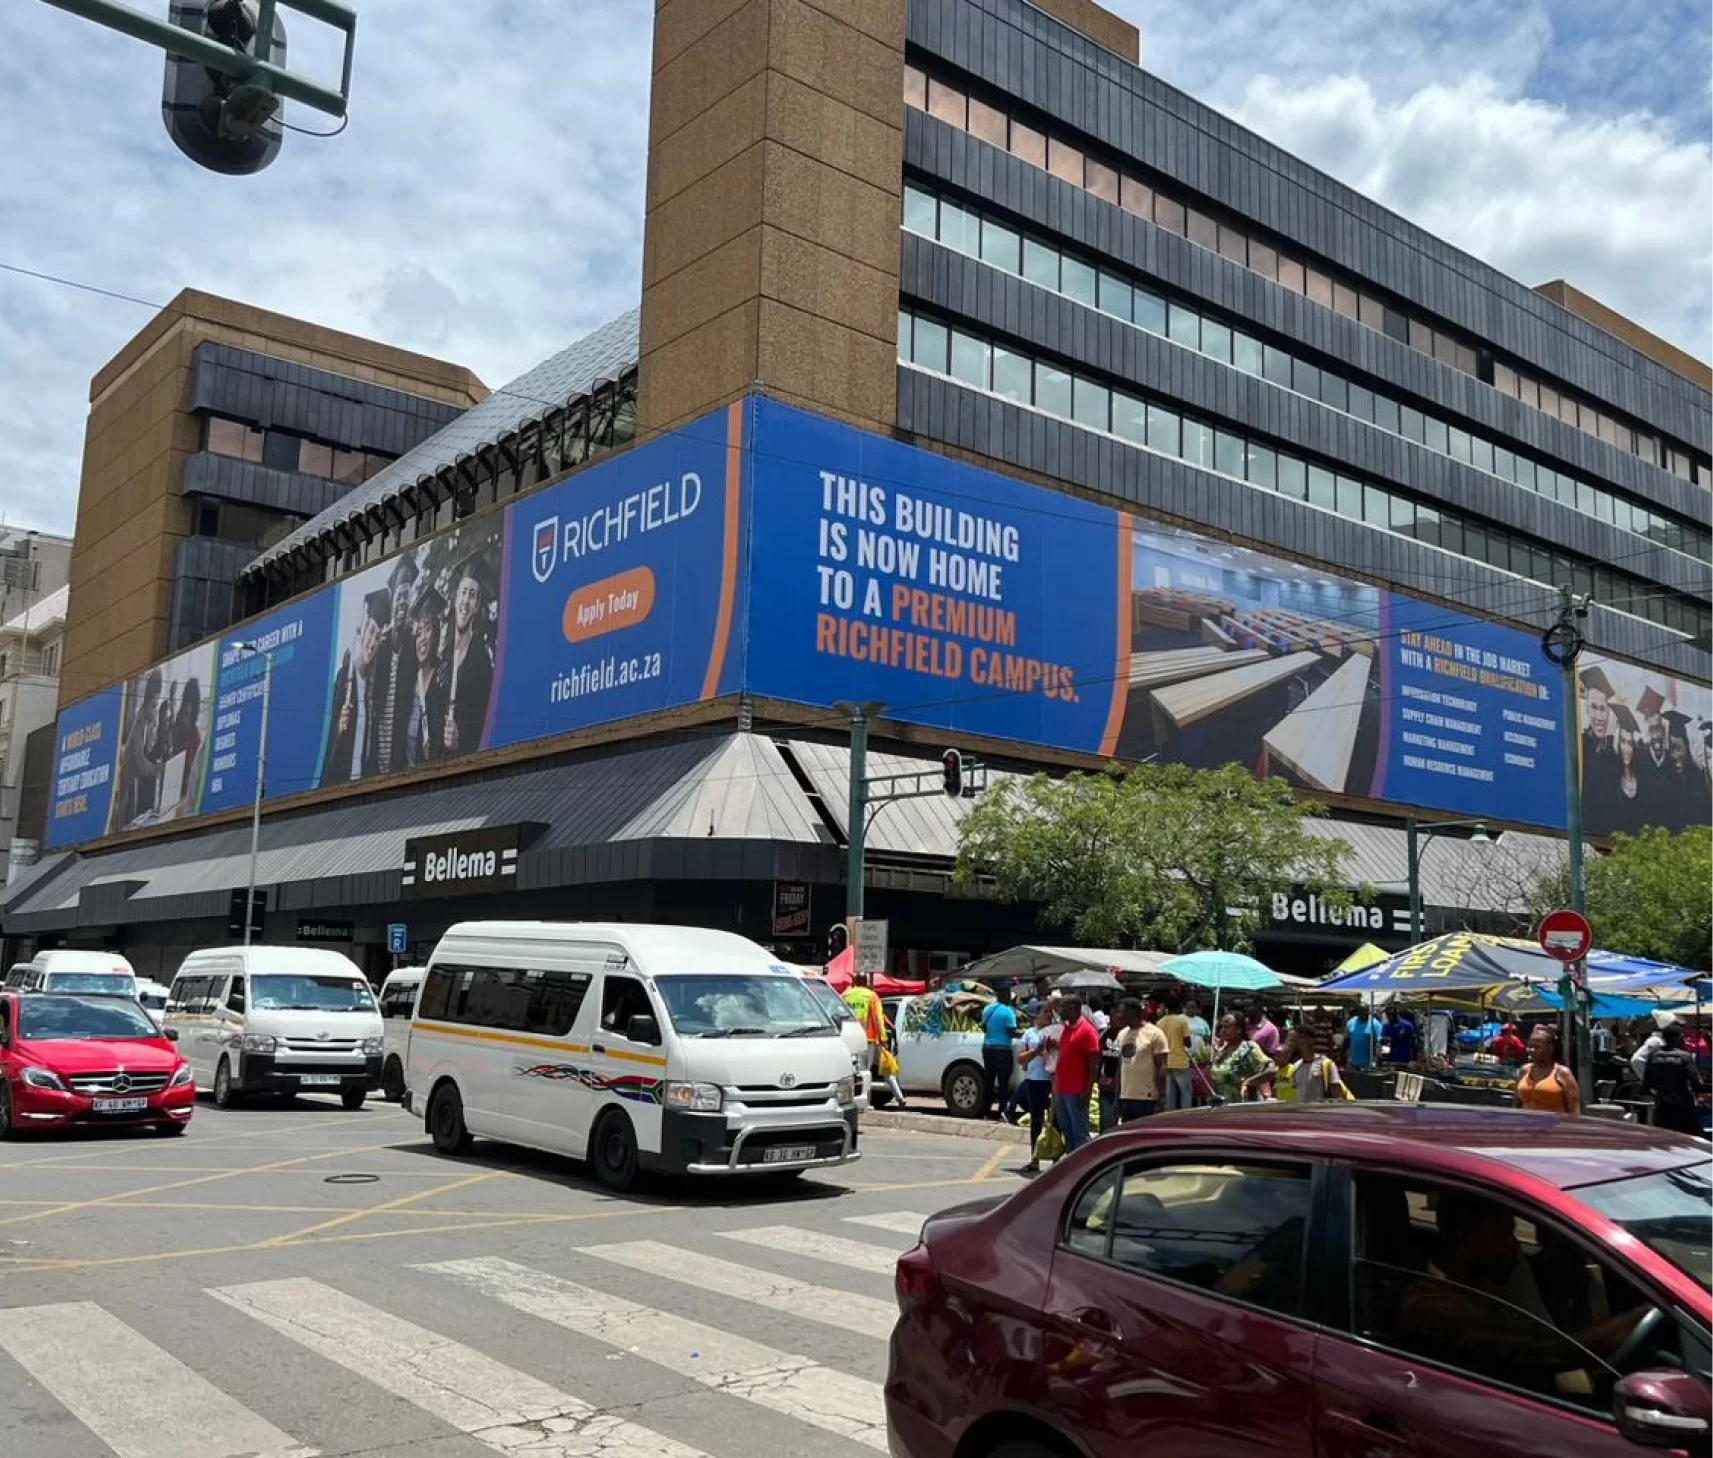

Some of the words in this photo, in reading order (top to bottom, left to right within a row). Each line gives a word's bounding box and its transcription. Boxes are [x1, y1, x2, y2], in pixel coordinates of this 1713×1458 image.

[563, 471, 702, 563] RICHFIELD
[819, 470, 887, 526] THIS
[894, 493, 1020, 562] BUILDING
[819, 518, 848, 562] IS
[857, 528, 920, 580] NOW
[928, 547, 1003, 601] HOME
[577, 603, 604, 627] Apply
[608, 589, 640, 616] Today
[816, 565, 854, 610] TO
[863, 578, 882, 618] A
[891, 583, 1017, 648] PREMIUM
[551, 652, 662, 704] richfield.ac.za
[816, 612, 963, 680] RICHFIELD
[969, 646, 1081, 703] CAMPUS.
[1400, 628, 1422, 648] STAY
[1424, 634, 1453, 657] AHEAD
[1465, 646, 1481, 666] THE
[1483, 651, 1498, 669] JOB
[1499, 656, 1531, 678] MARKET
[1400, 648, 1423, 669] WITH
[1425, 655, 1432, 672] A
[1433, 657, 1478, 683] RICHFIELD
[424, 847, 496, 882] Bellema
[302, 924, 349, 937] Bellema
[1272, 892, 1384, 929] Bellema
[1390, 943, 1439, 979] FIRS
